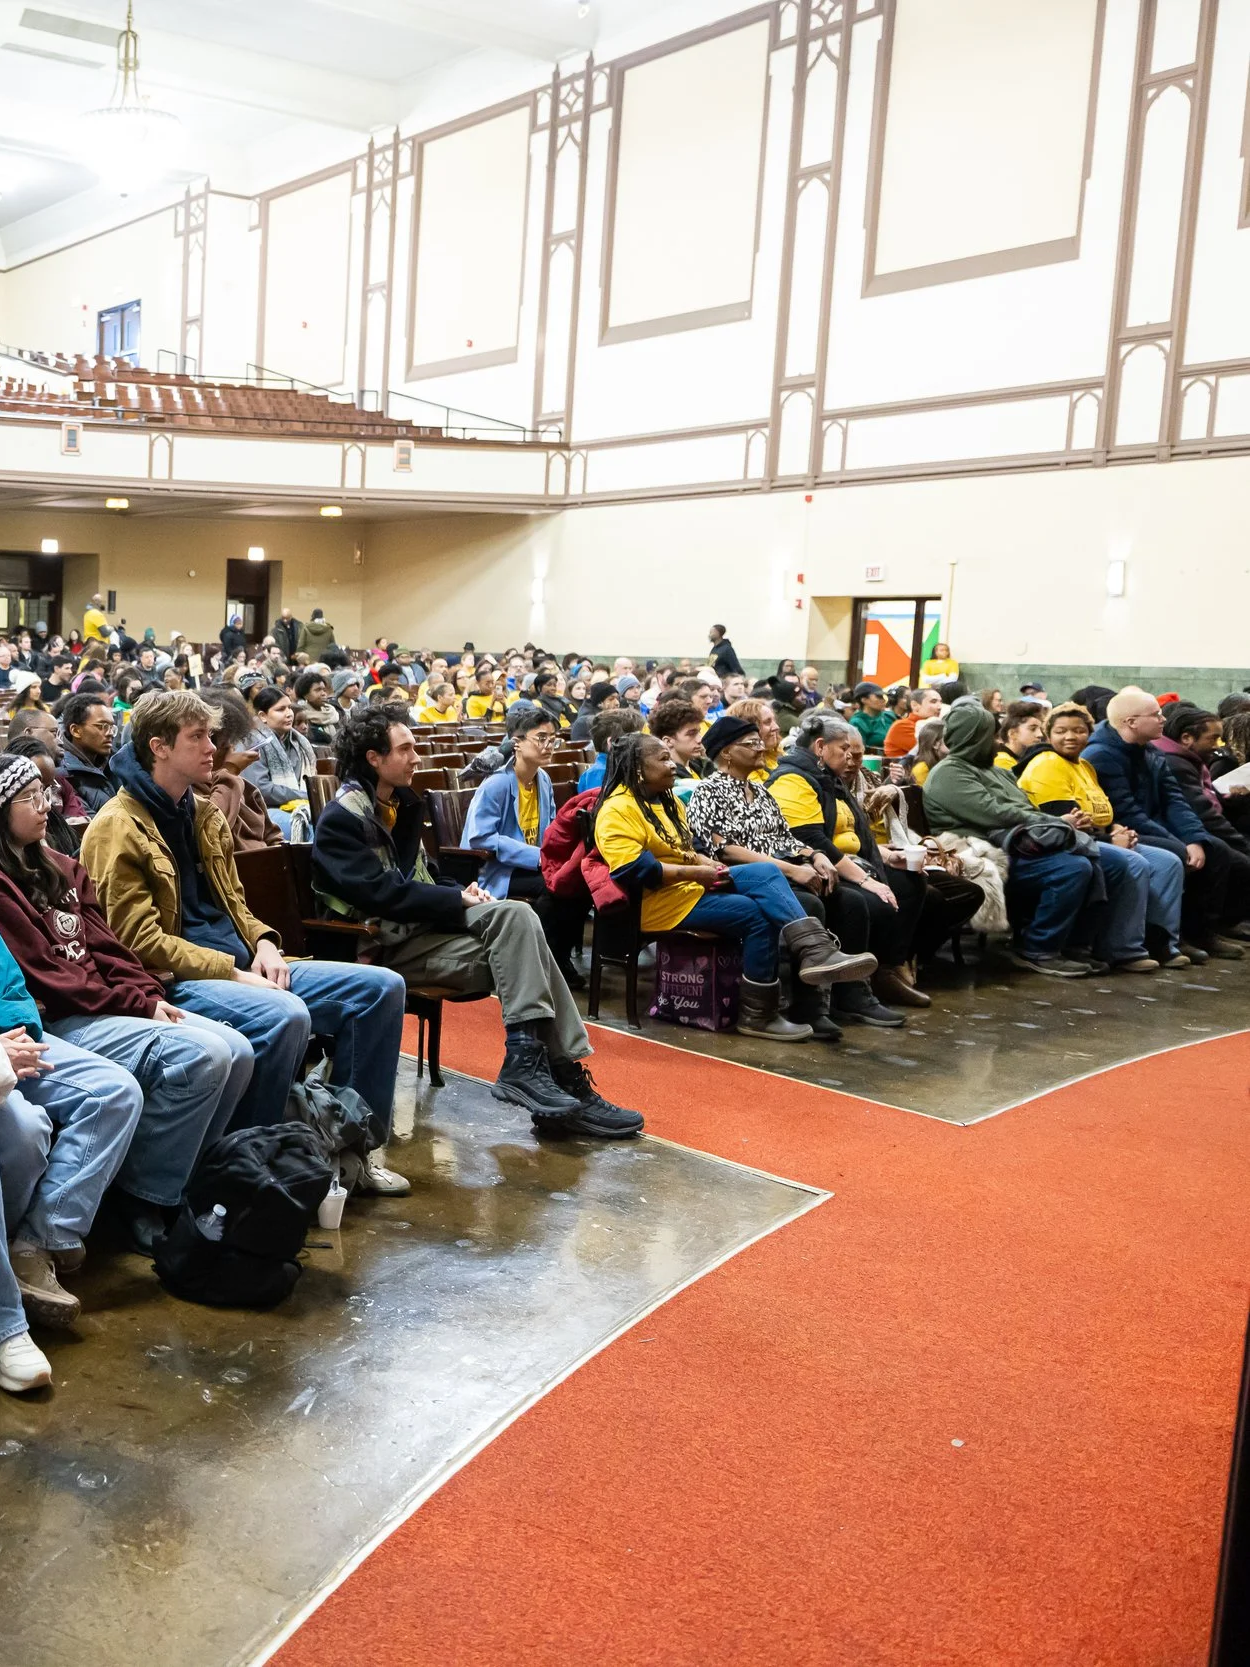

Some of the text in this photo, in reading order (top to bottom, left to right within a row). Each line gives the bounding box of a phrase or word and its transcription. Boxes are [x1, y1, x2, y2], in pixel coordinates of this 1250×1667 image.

[866, 567, 880, 578] EXIT
[661, 971, 705, 984] STRONG
[670, 995, 700, 1009] You
